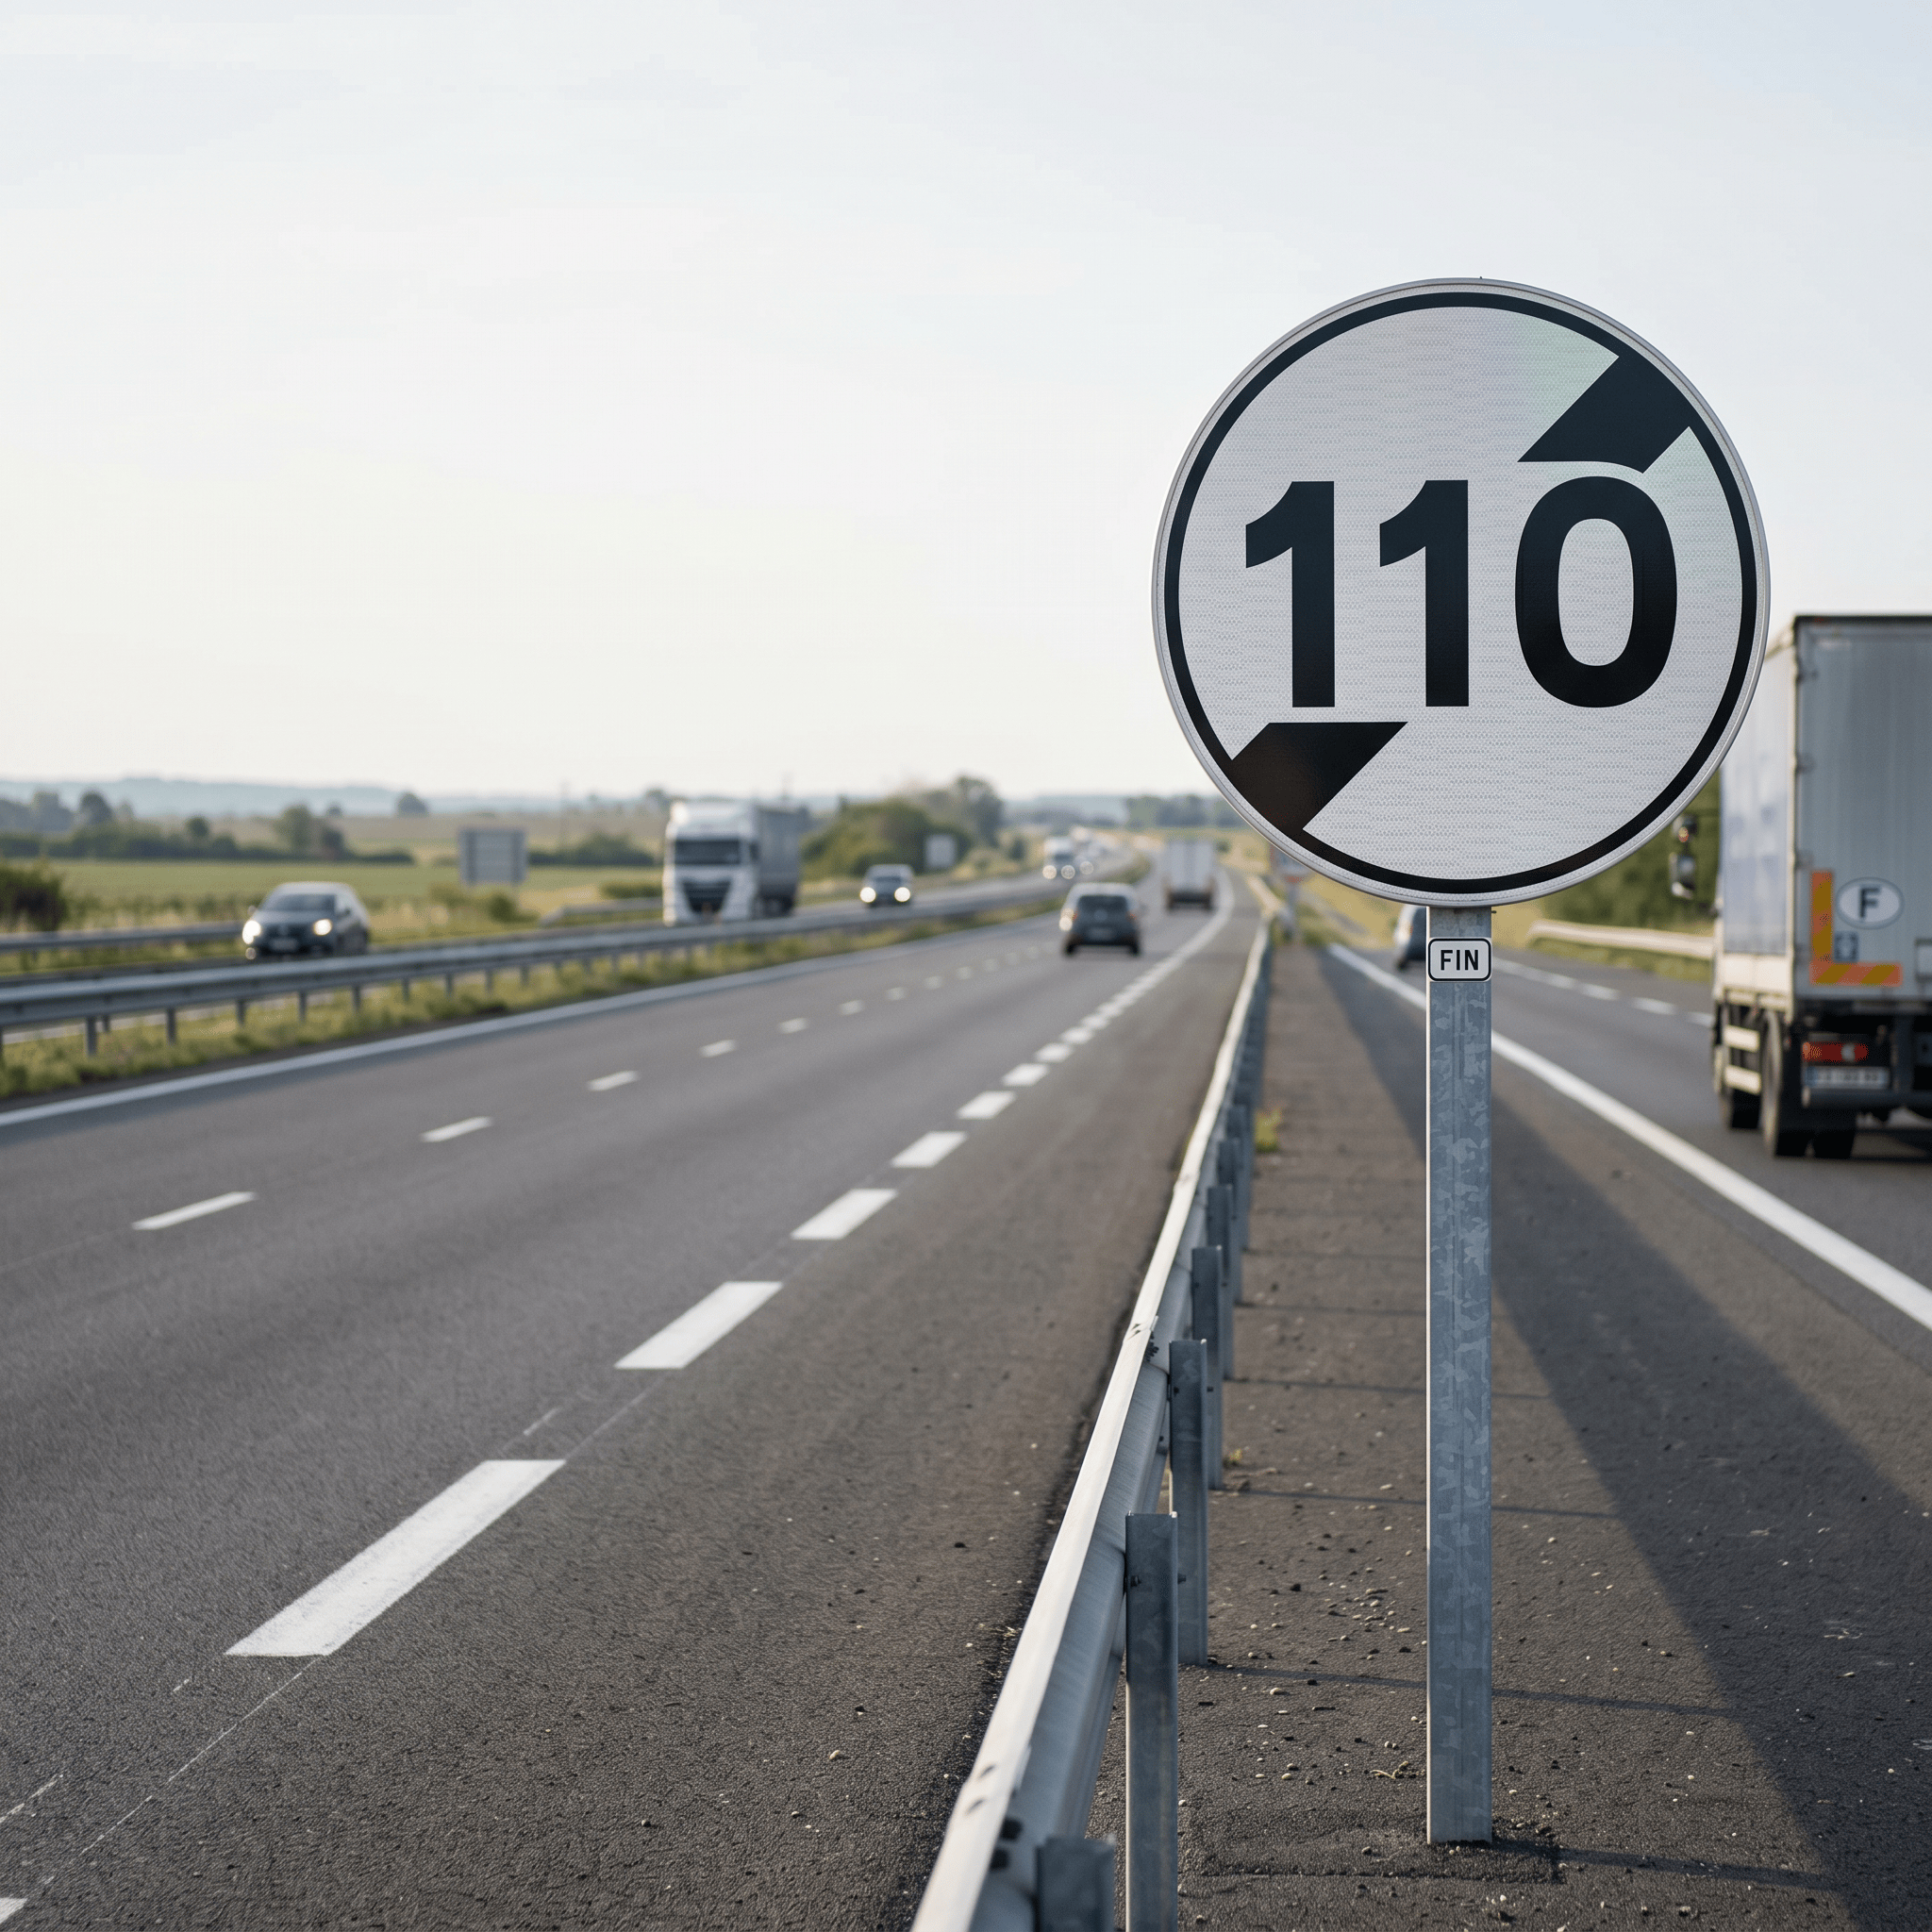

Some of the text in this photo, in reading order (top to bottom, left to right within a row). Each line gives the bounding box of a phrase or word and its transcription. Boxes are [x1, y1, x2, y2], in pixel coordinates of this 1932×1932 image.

[1245, 475, 1678, 708] 110
[1858, 886, 1882, 920] F
[1440, 949, 1479, 971] FIN
